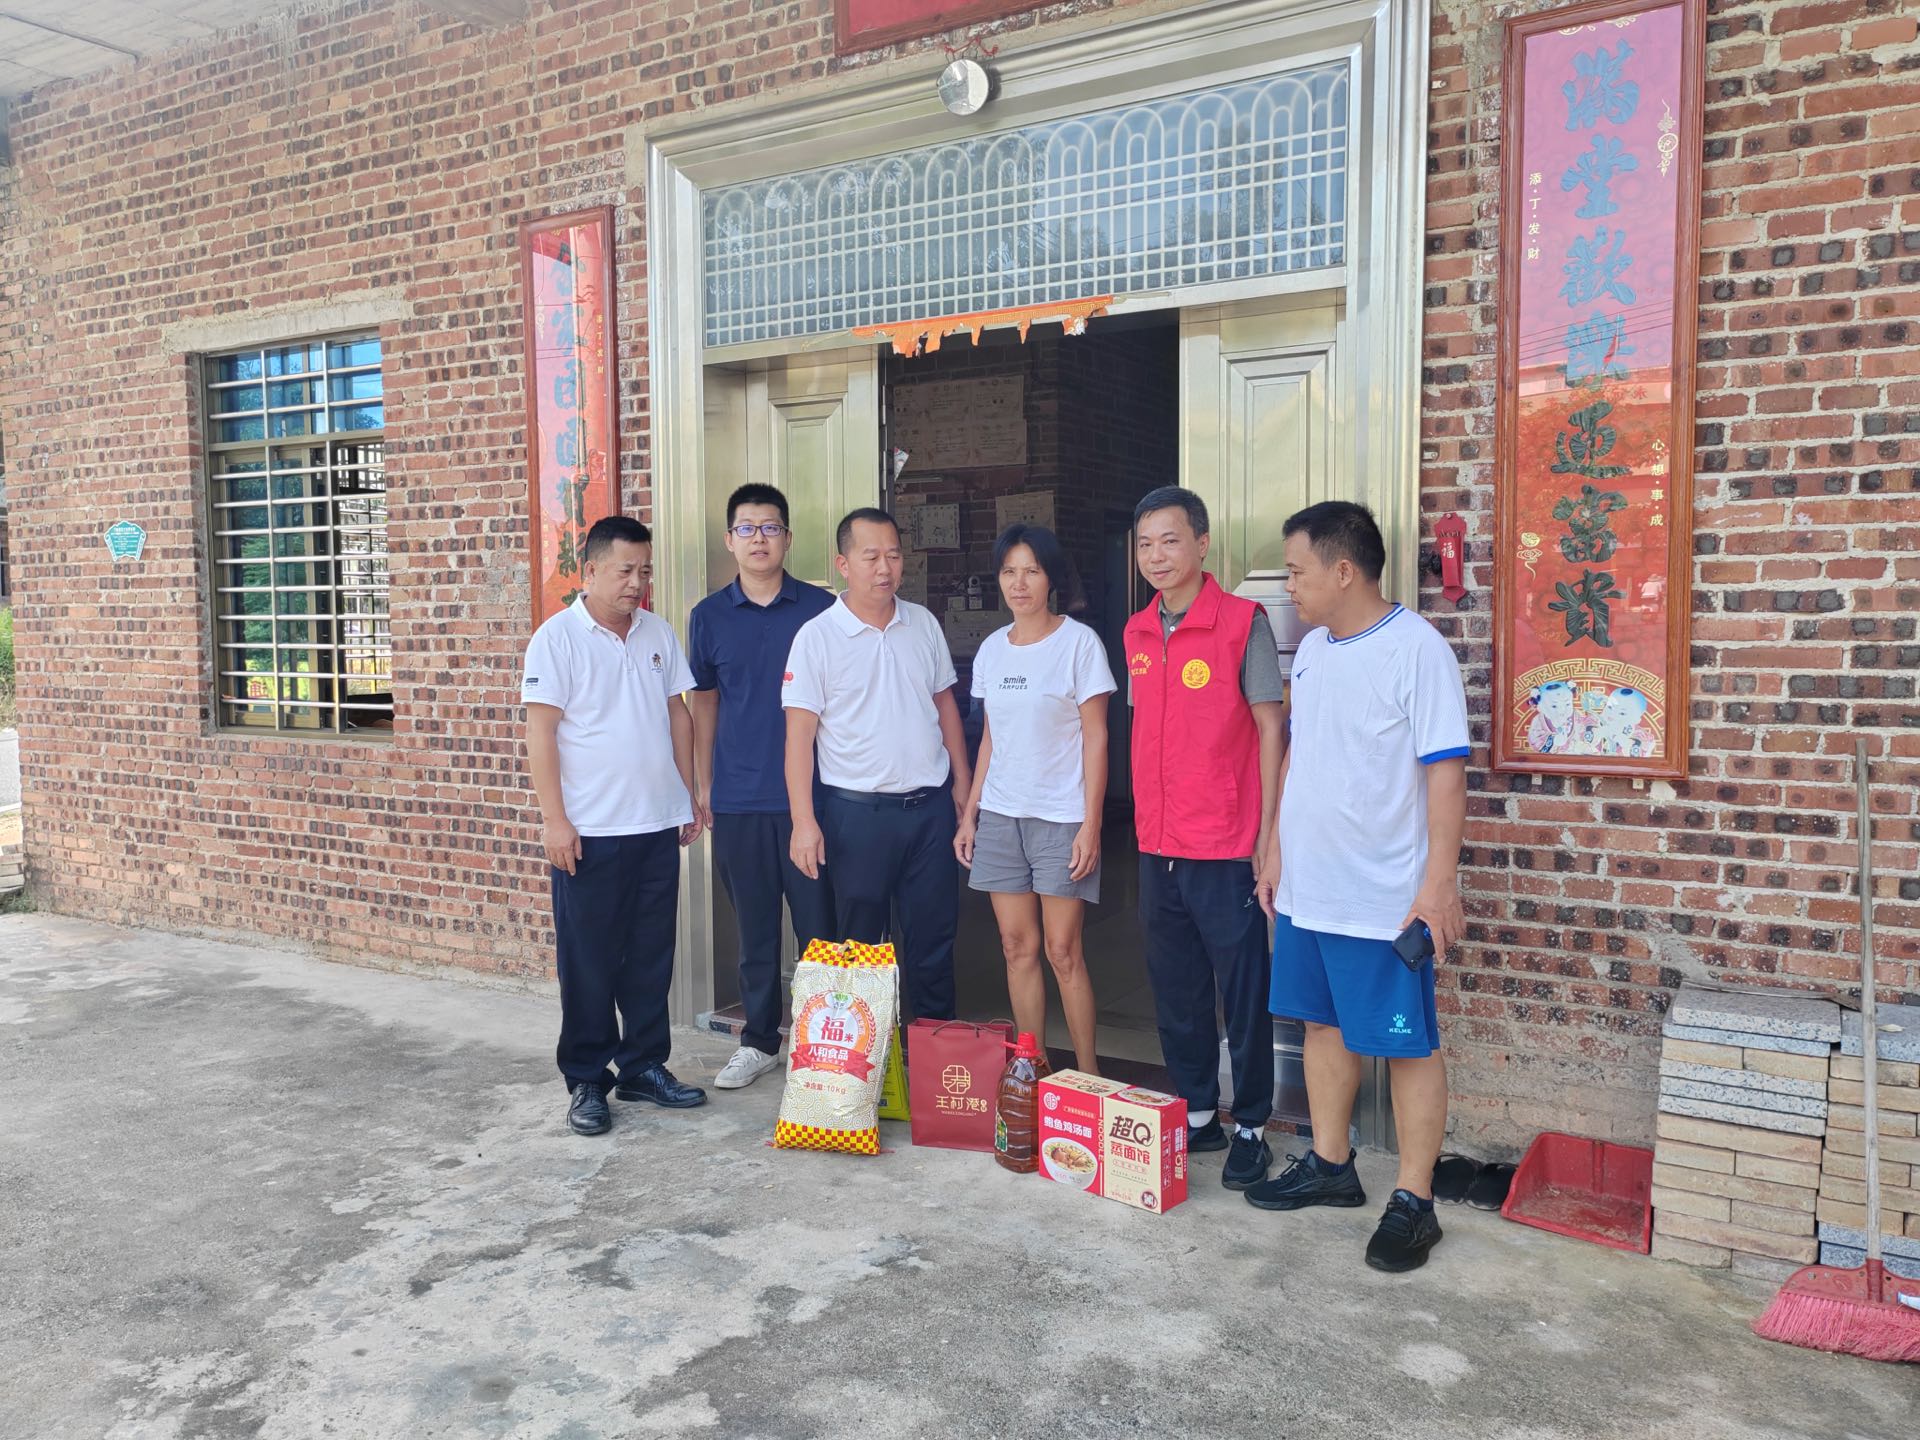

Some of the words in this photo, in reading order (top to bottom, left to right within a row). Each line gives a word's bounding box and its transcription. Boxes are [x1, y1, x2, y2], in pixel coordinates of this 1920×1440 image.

[1441, 541, 1455, 559] 福
[1003, 675, 1027, 684] smile
[1388, 1027, 1412, 1035] KELME
[808, 1045, 849, 1061] 八和食品
[1043, 1116, 1093, 1139] 鲍鱼鸡汤面
[1109, 1115, 1155, 1147] 超Q
[1110, 1140, 1151, 1166] 蒸面馆
